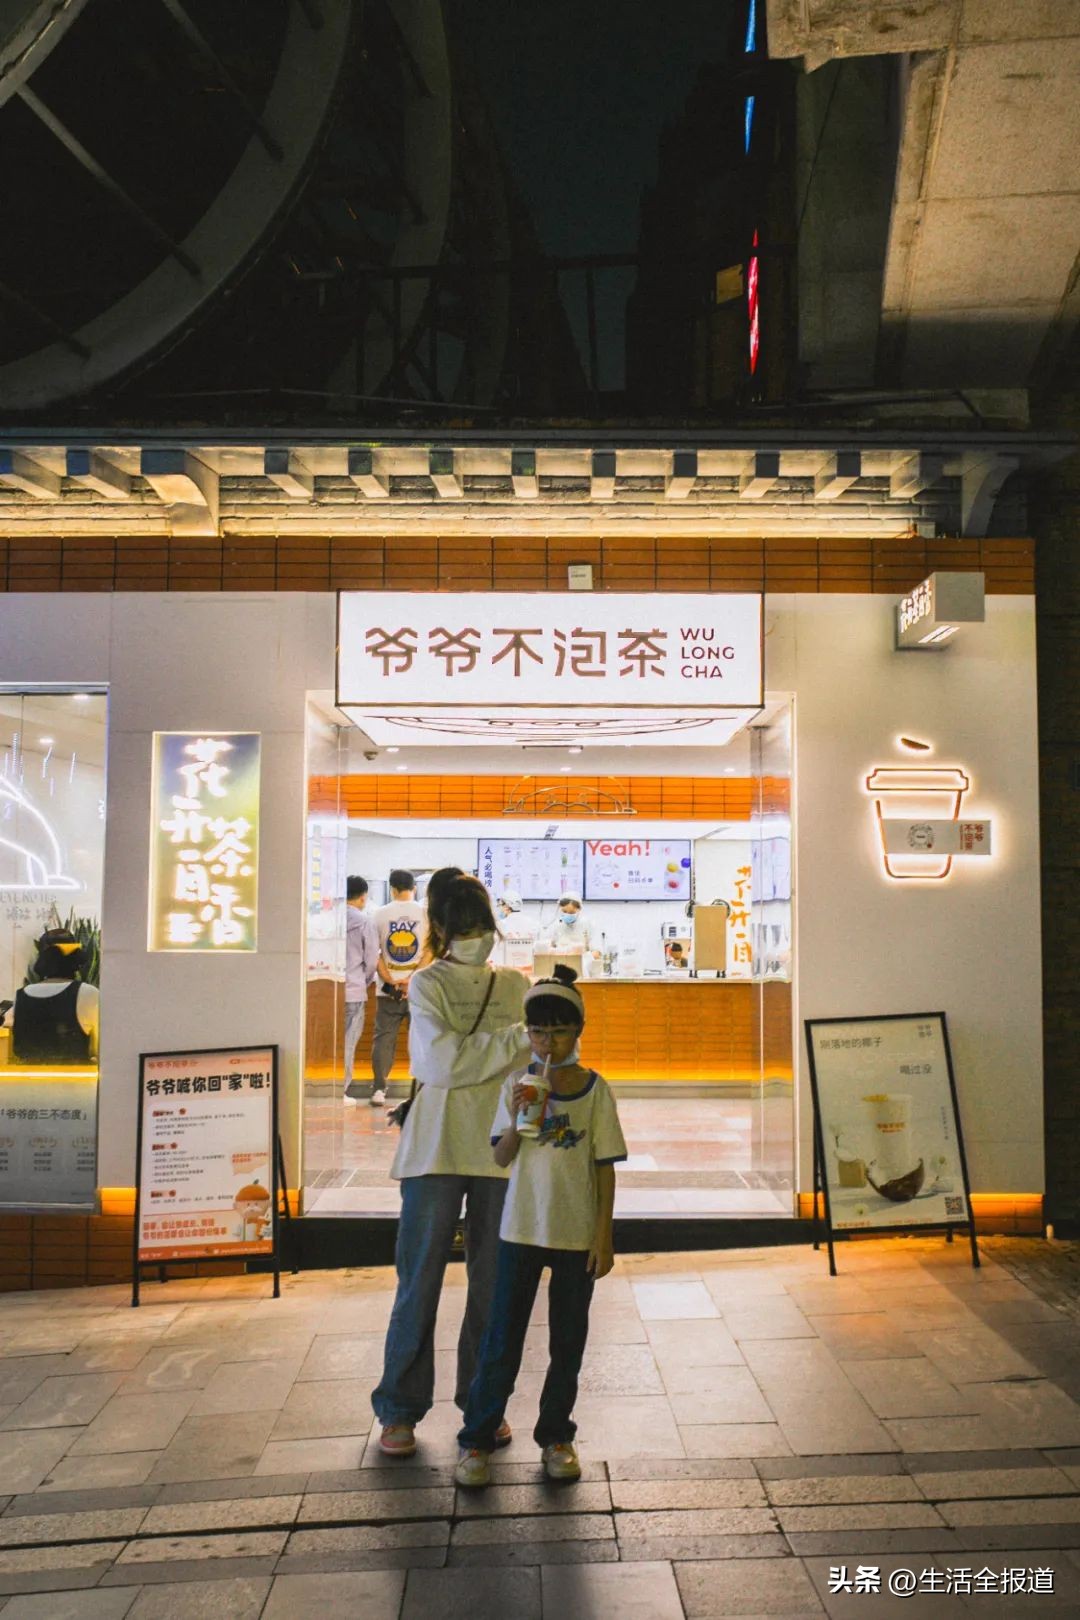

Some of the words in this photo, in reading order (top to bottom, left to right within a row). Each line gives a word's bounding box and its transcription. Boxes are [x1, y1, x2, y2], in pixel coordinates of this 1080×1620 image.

[680, 628, 715, 641] WU
[365, 627, 668, 678] 爷爷不泡茶
[681, 646, 735, 660] LONG
[681, 665, 723, 678] CHA
[587, 840, 650, 857] Yeah!
[390, 921, 416, 932] BAY
